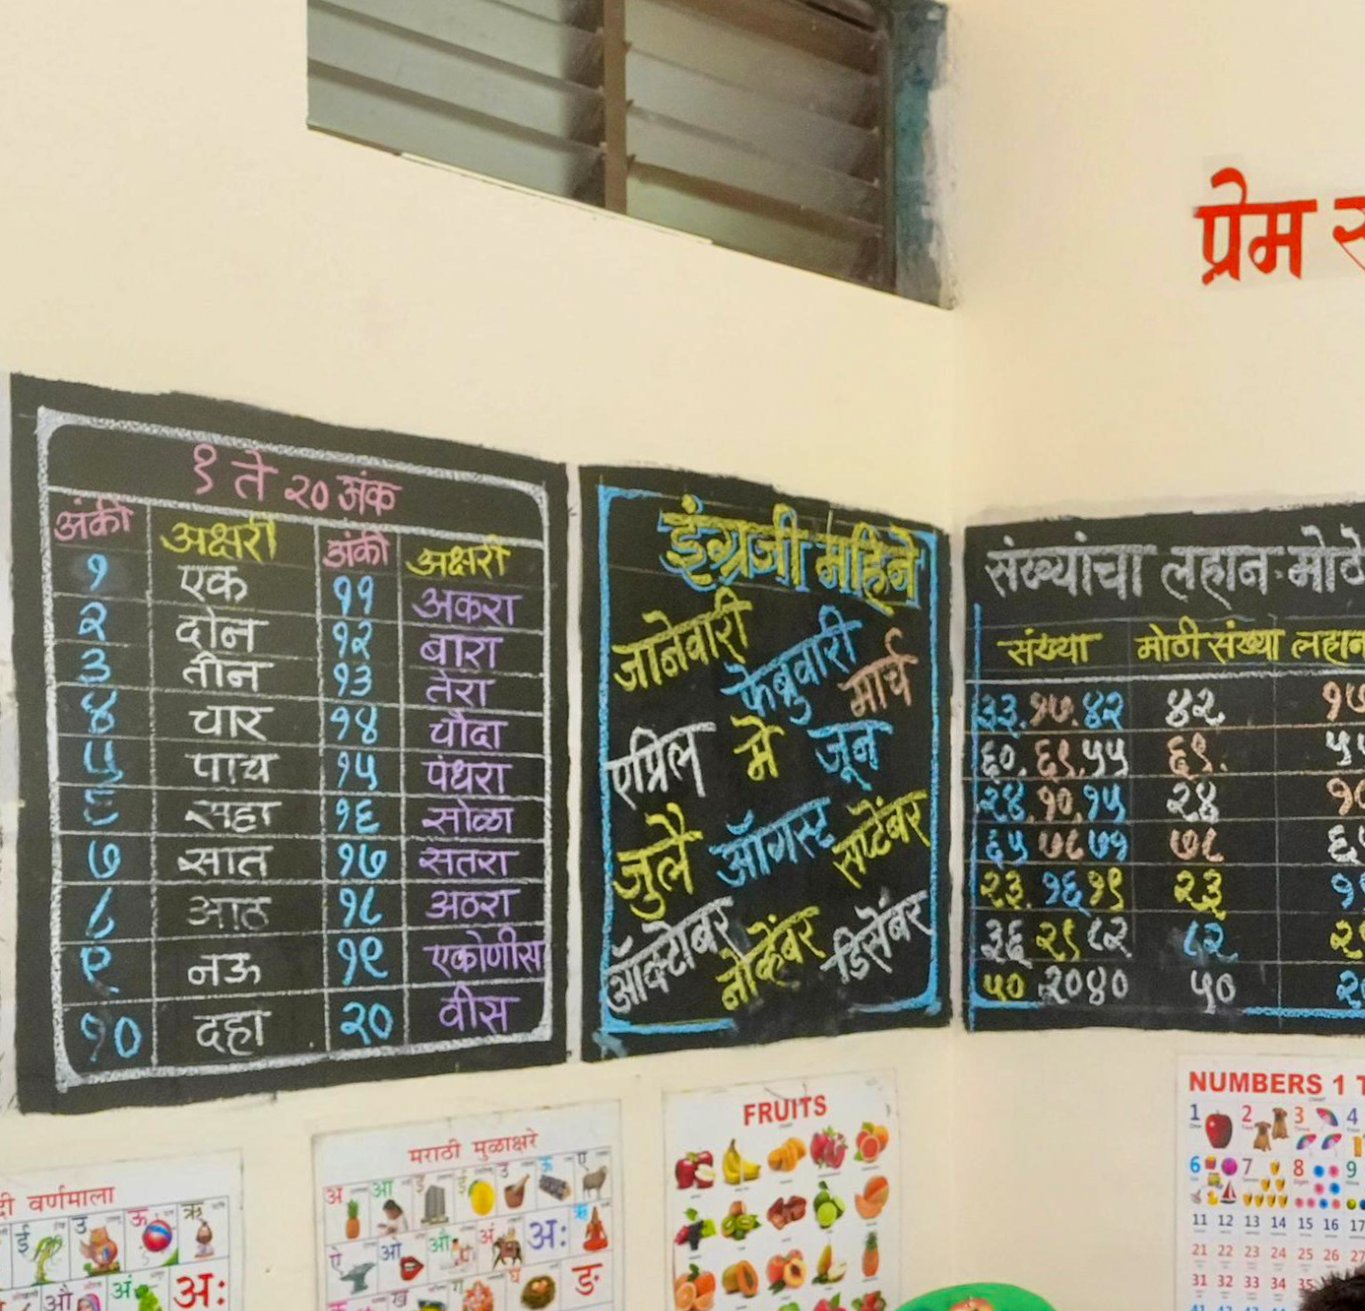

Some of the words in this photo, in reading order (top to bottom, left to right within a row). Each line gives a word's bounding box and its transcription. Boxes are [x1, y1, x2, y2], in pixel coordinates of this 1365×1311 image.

[1194, 168, 1316, 285] प्रेम
[232, 449, 278, 501] ते
[284, 474, 328, 511] २०
[336, 472, 402, 516] अंक
[161, 516, 277, 563] अक्षरी
[322, 531, 390, 569] अंकी
[406, 534, 511, 579] अक्षरी
[657, 494, 813, 592] इंग्रजी
[985, 531, 1157, 599] संख्यांचा
[1160, 541, 1285, 610] लहान
[177, 565, 247, 603] एक
[333, 575, 375, 616] ११
[412, 587, 522, 626] अकरा
[176, 608, 268, 652] दोन
[333, 622, 373, 658] १२
[420, 633, 503, 669] बारा
[612, 586, 752, 692] जानेवारी
[837, 627, 919, 717] मार्च
[997, 626, 1103, 667] संख्या
[1134, 616, 1213, 662] मोठी
[1208, 619, 1285, 664] संख्या
[182, 653, 274, 692] तीन
[333, 663, 373, 698] १३
[426, 673, 495, 708] तेरा
[189, 705, 274, 740] चार
[331, 706, 377, 744] १४
[429, 712, 508, 751] चौदा
[194, 752, 279, 785] पाच
[337, 755, 377, 789] १५
[422, 755, 513, 795] पंधरा
[605, 721, 717, 810] एप्रिल
[731, 714, 785, 781] मे
[807, 720, 893, 791] जून
[186, 800, 281, 833] सहा
[336, 798, 379, 834] १६
[422, 801, 513, 836] सोळा
[1167, 782, 1221, 823] २४
[179, 847, 274, 879] सात
[340, 843, 386, 879] १७
[419, 849, 519, 879] सतरा
[613, 802, 703, 920] जुलै
[709, 796, 836, 887] ऑगस्ट
[1169, 827, 1225, 862] ७८
[187, 896, 272, 931] आठ
[339, 888, 382, 927] १८
[426, 889, 520, 920] अठरा
[1173, 869, 1227, 921] २३
[188, 952, 263, 987] नऊ
[339, 937, 388, 985] १९
[424, 931, 546, 975] एकोणीस
[820, 886, 933, 985] डिसेंबर
[195, 1010, 272, 1056] दहा
[341, 1002, 392, 1045] २०
[440, 987, 520, 1033] वीस
[743, 1094, 828, 1127] FRUITS
[1189, 1071, 1323, 1095] NUMBERS
[1333, 1075, 1345, 1095] 1
[407, 1139, 461, 1165] मराठी
[473, 1127, 540, 1160] मुळाक्षरे
[27, 1186, 116, 1215] वर्णमाला
